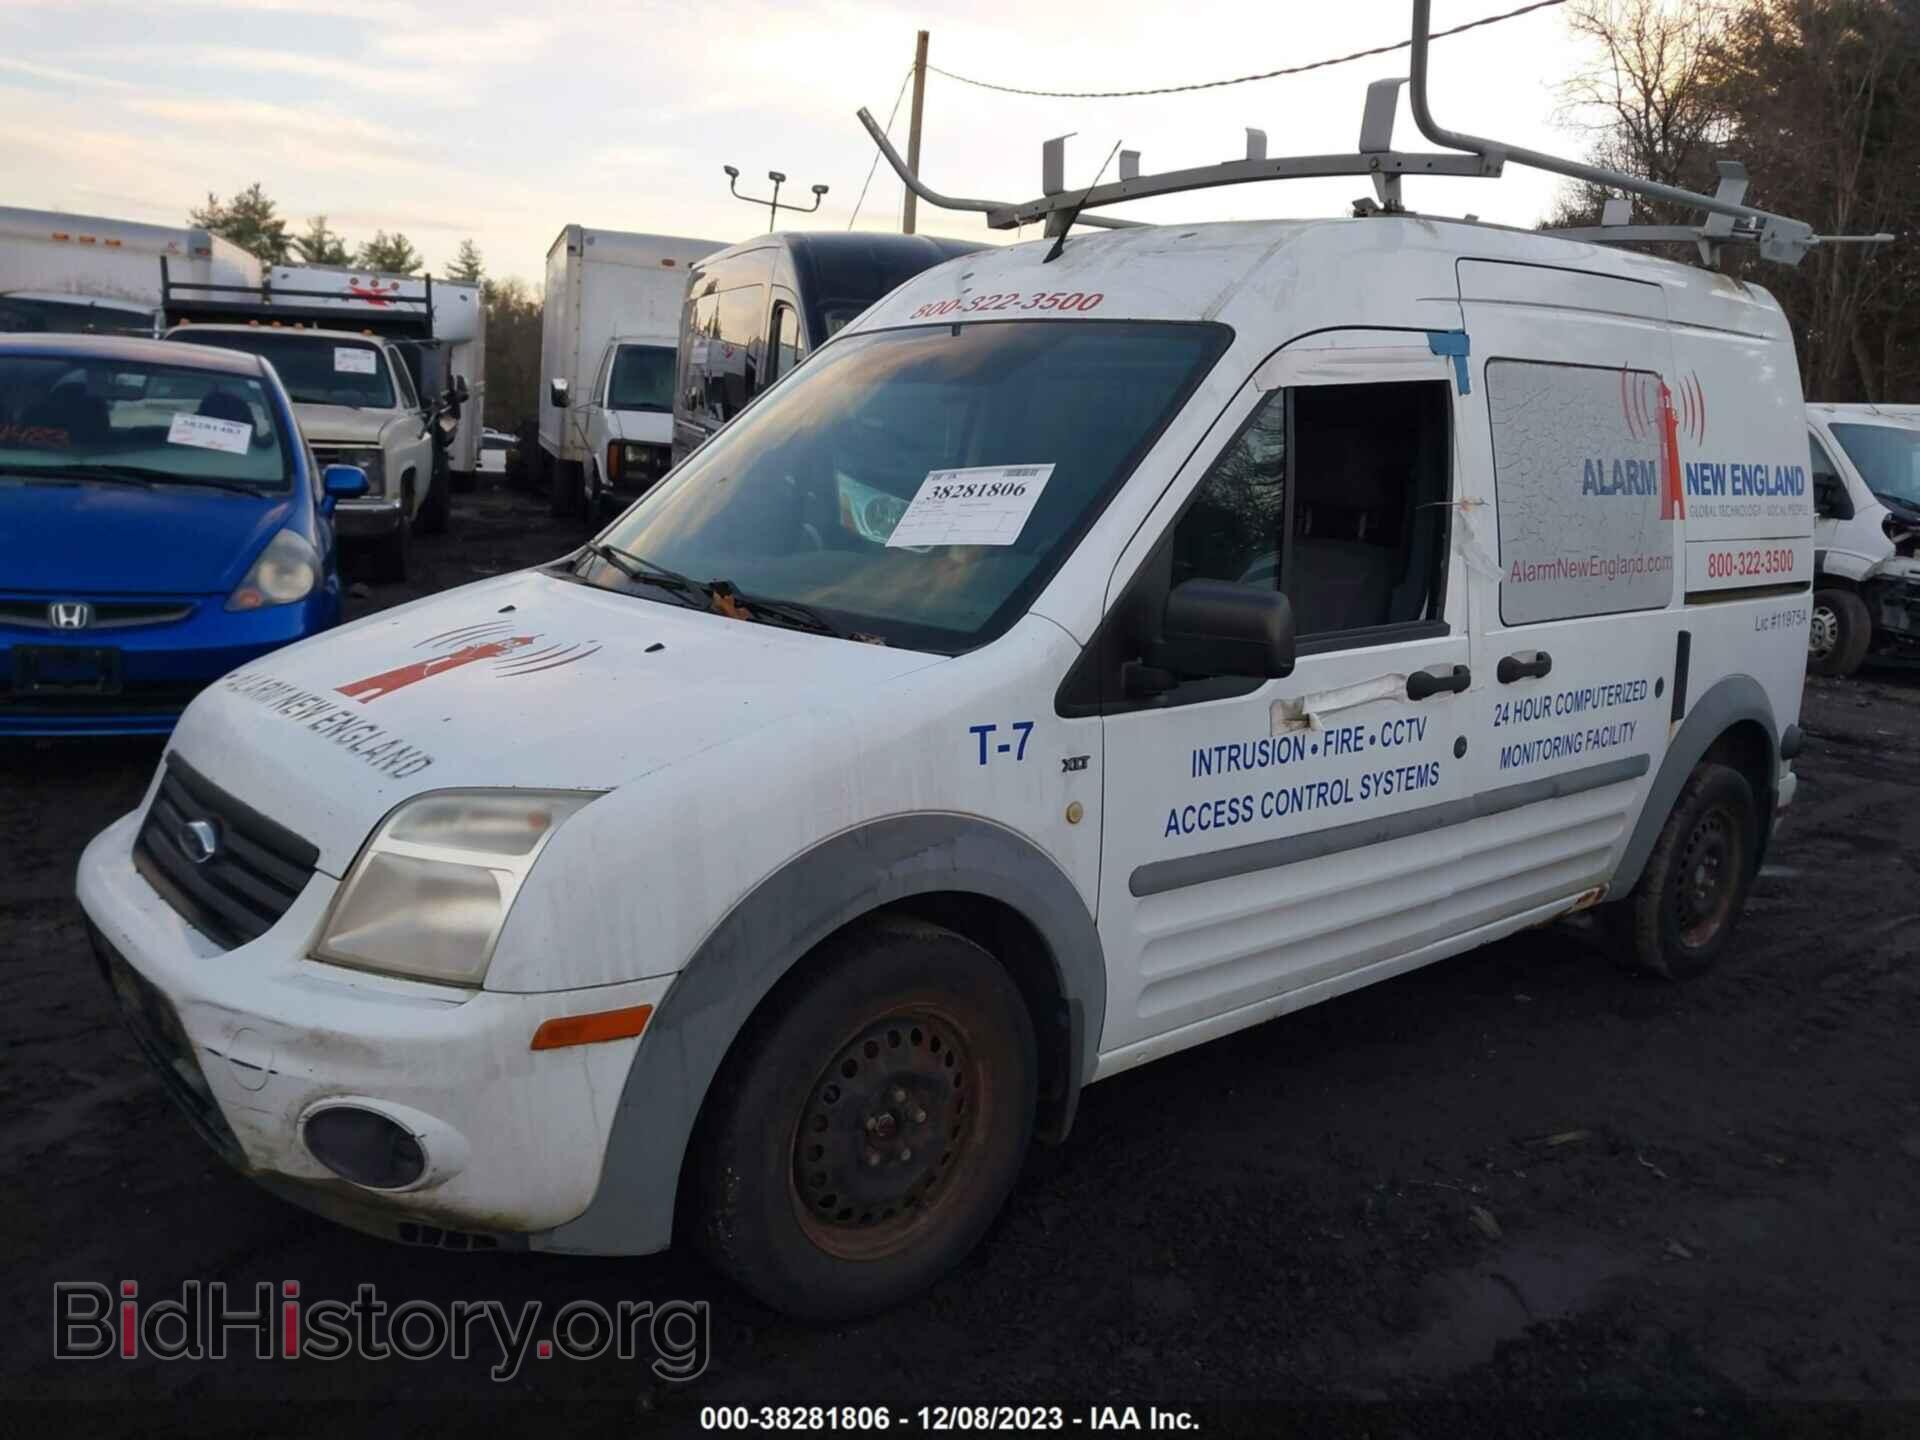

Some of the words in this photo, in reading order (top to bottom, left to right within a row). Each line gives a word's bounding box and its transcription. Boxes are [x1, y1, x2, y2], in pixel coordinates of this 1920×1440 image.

[910, 293, 1104, 319] 800-322-3500
[926, 481, 1030, 500] 38281806
[1582, 458, 1657, 496] ALARM
[1685, 462, 1727, 496] NEW
[1732, 464, 1804, 496] ENGLAND
[1510, 553, 1673, 584] AlarmNewEngland.com
[1708, 549, 1793, 578] 800-322-3500
[1494, 702, 1510, 727] 24
[1513, 696, 1552, 724] HOUR
[1555, 679, 1648, 716] COMPUTERIZED
[268, 690, 339, 722] NEW
[307, 709, 434, 780] ENGLAND
[969, 721, 1034, 765] T-7
[1191, 735, 1306, 778] INTRUSION
[1323, 725, 1365, 757] FIRE
[1380, 716, 1427, 748] CCTV
[1500, 732, 1583, 769] MONITORING
[1585, 721, 1637, 751] FACILITY
[1164, 796, 1254, 838] ACCESS
[1260, 777, 1354, 819] CONTROL
[1359, 761, 1440, 800] SYSTEMS
